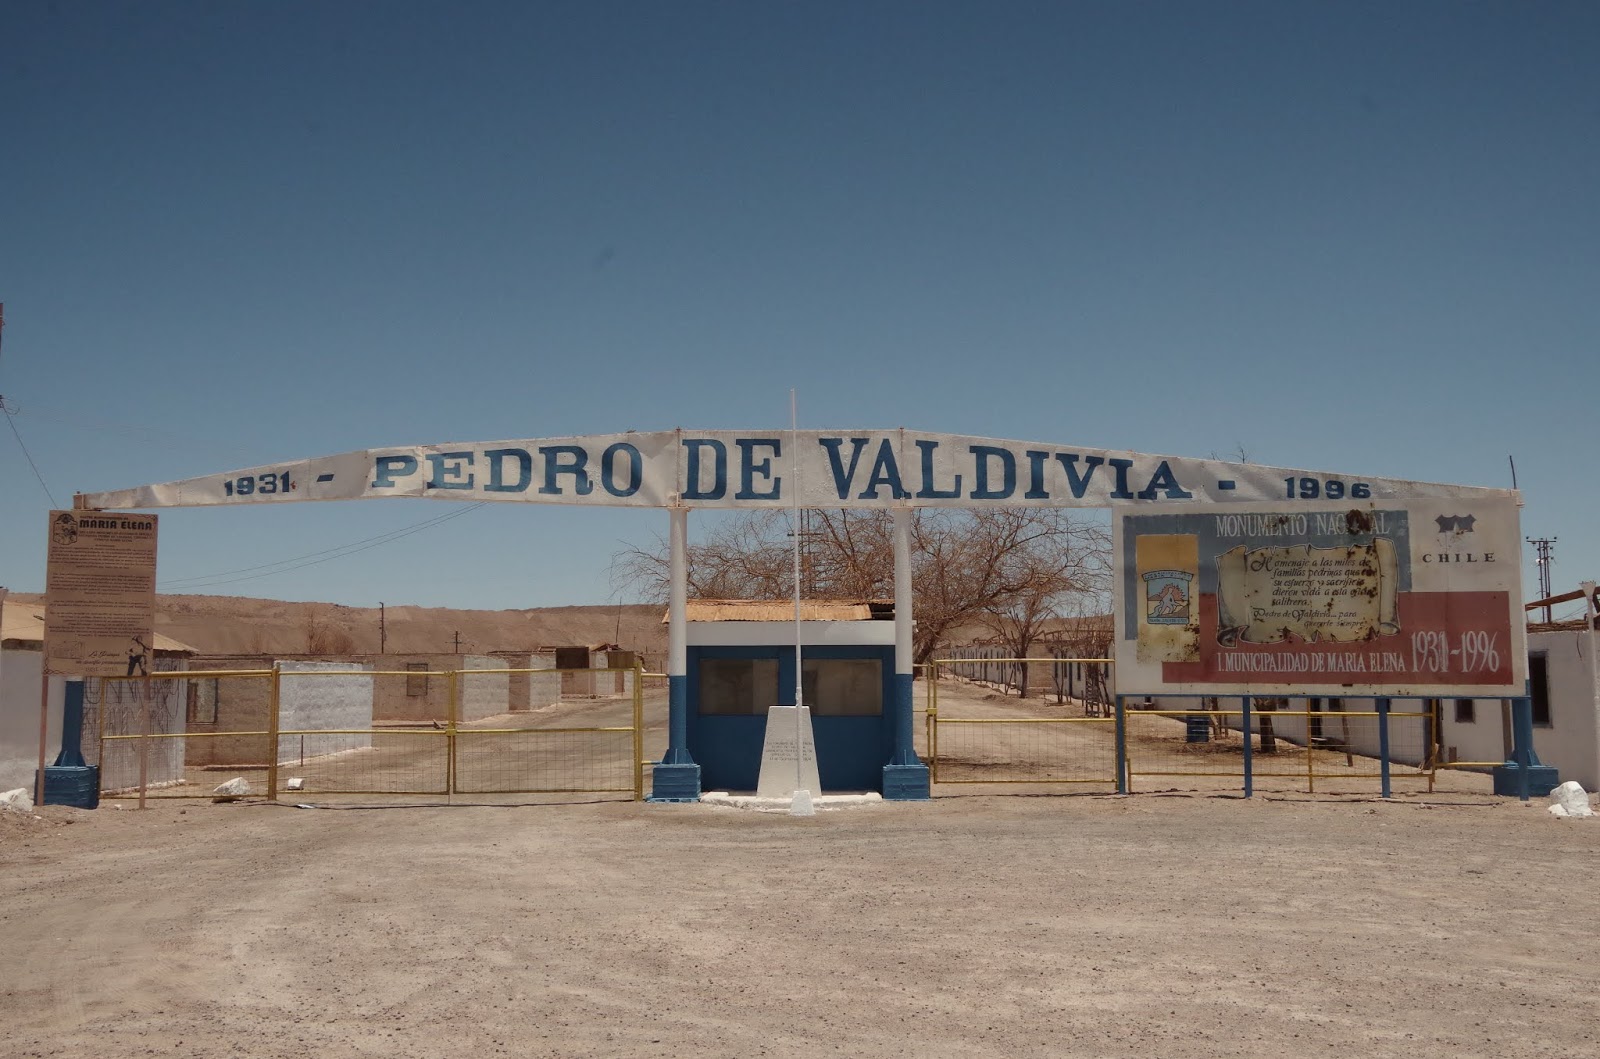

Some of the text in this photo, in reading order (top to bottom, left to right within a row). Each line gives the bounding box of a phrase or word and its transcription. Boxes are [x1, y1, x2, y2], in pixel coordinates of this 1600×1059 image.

[224, 470, 292, 497] 1931
[371, 442, 643, 497] PEDRO
[681, 438, 782, 500] DE
[818, 438, 1192, 500] VALDIVIA
[1285, 476, 1371, 499] 1996
[79, 519, 152, 531] MARIA ELENA
[1215, 513, 1308, 538] MONUMENTO
[1312, 559, 1318, 567] a
[1320, 556, 1332, 567] las
[1422, 552, 1496, 563] CHILE
[1273, 579, 1283, 587] su
[1272, 587, 1298, 597] dieron
[1301, 587, 1320, 596] vida
[1311, 652, 1325, 672] DE
[1327, 652, 1367, 672] MARIA
[1370, 652, 1407, 672] ELENA
